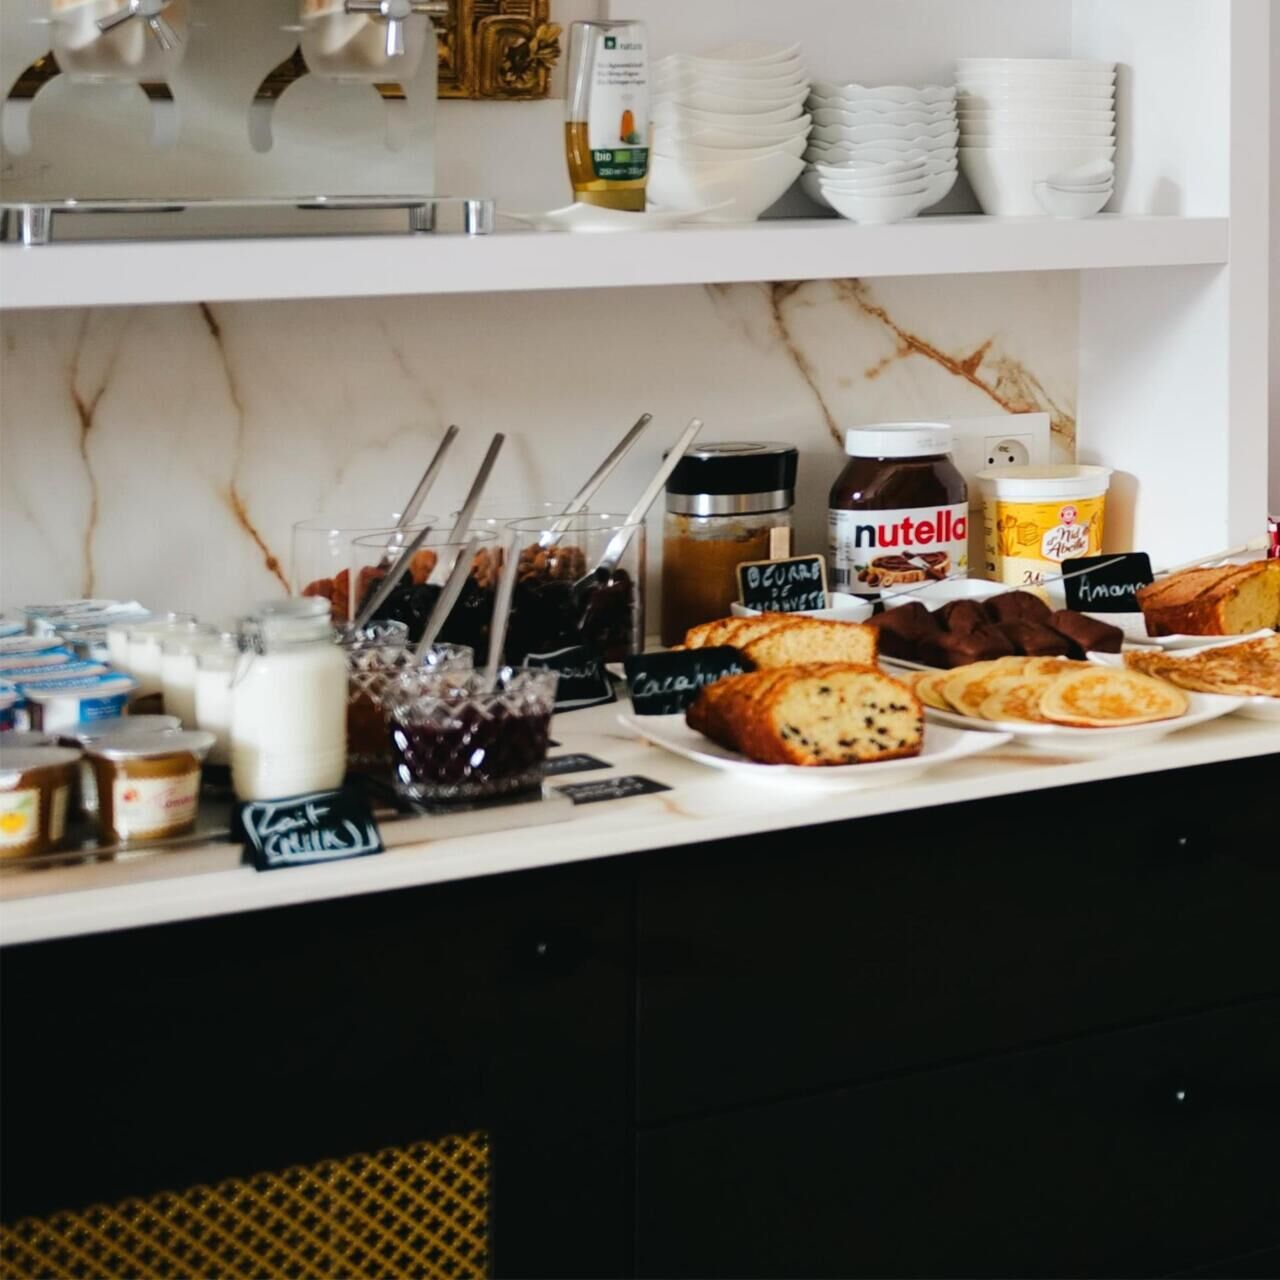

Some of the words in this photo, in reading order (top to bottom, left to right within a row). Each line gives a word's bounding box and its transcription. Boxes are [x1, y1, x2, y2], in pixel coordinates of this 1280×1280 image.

[854, 509, 967, 549] nutella
[746, 562, 821, 589] BEURRE
[771, 583, 793, 598] DE
